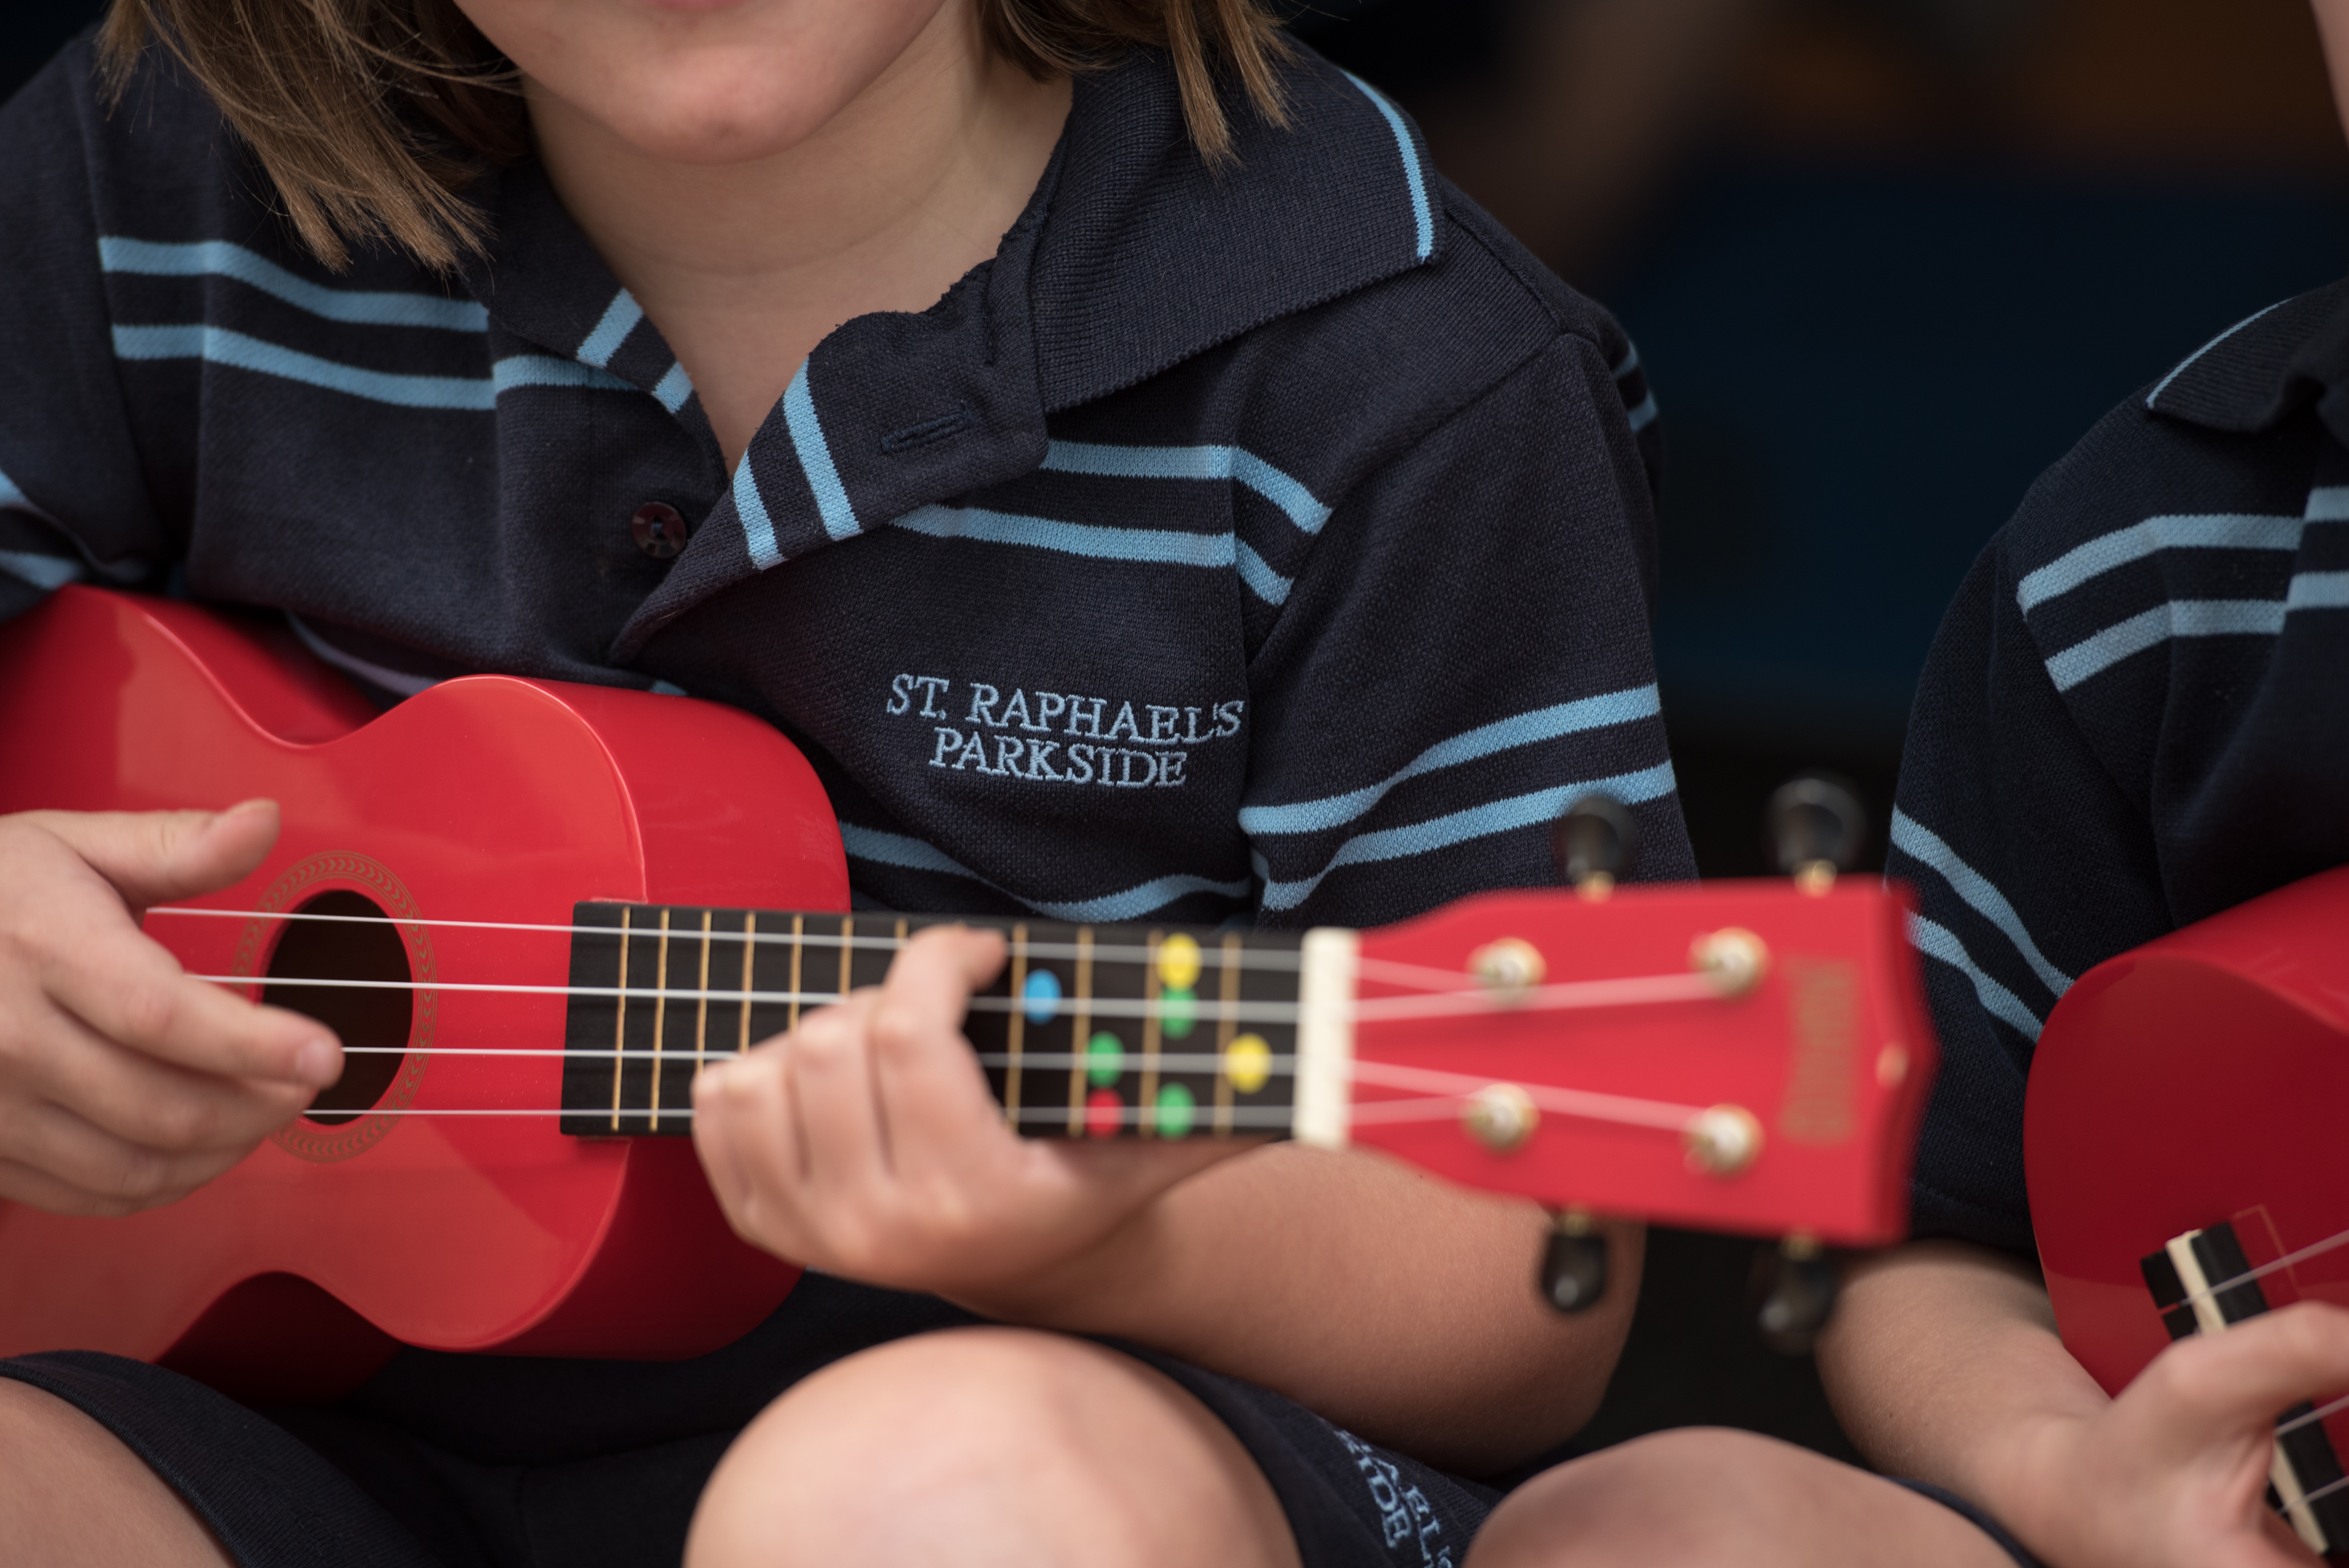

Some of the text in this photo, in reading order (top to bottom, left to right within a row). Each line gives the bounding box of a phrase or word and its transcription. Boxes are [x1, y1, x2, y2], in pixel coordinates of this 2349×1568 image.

[886, 673, 1244, 745] ST. RAPHAEL'S
[929, 727, 1187, 788] PARKSIDE
